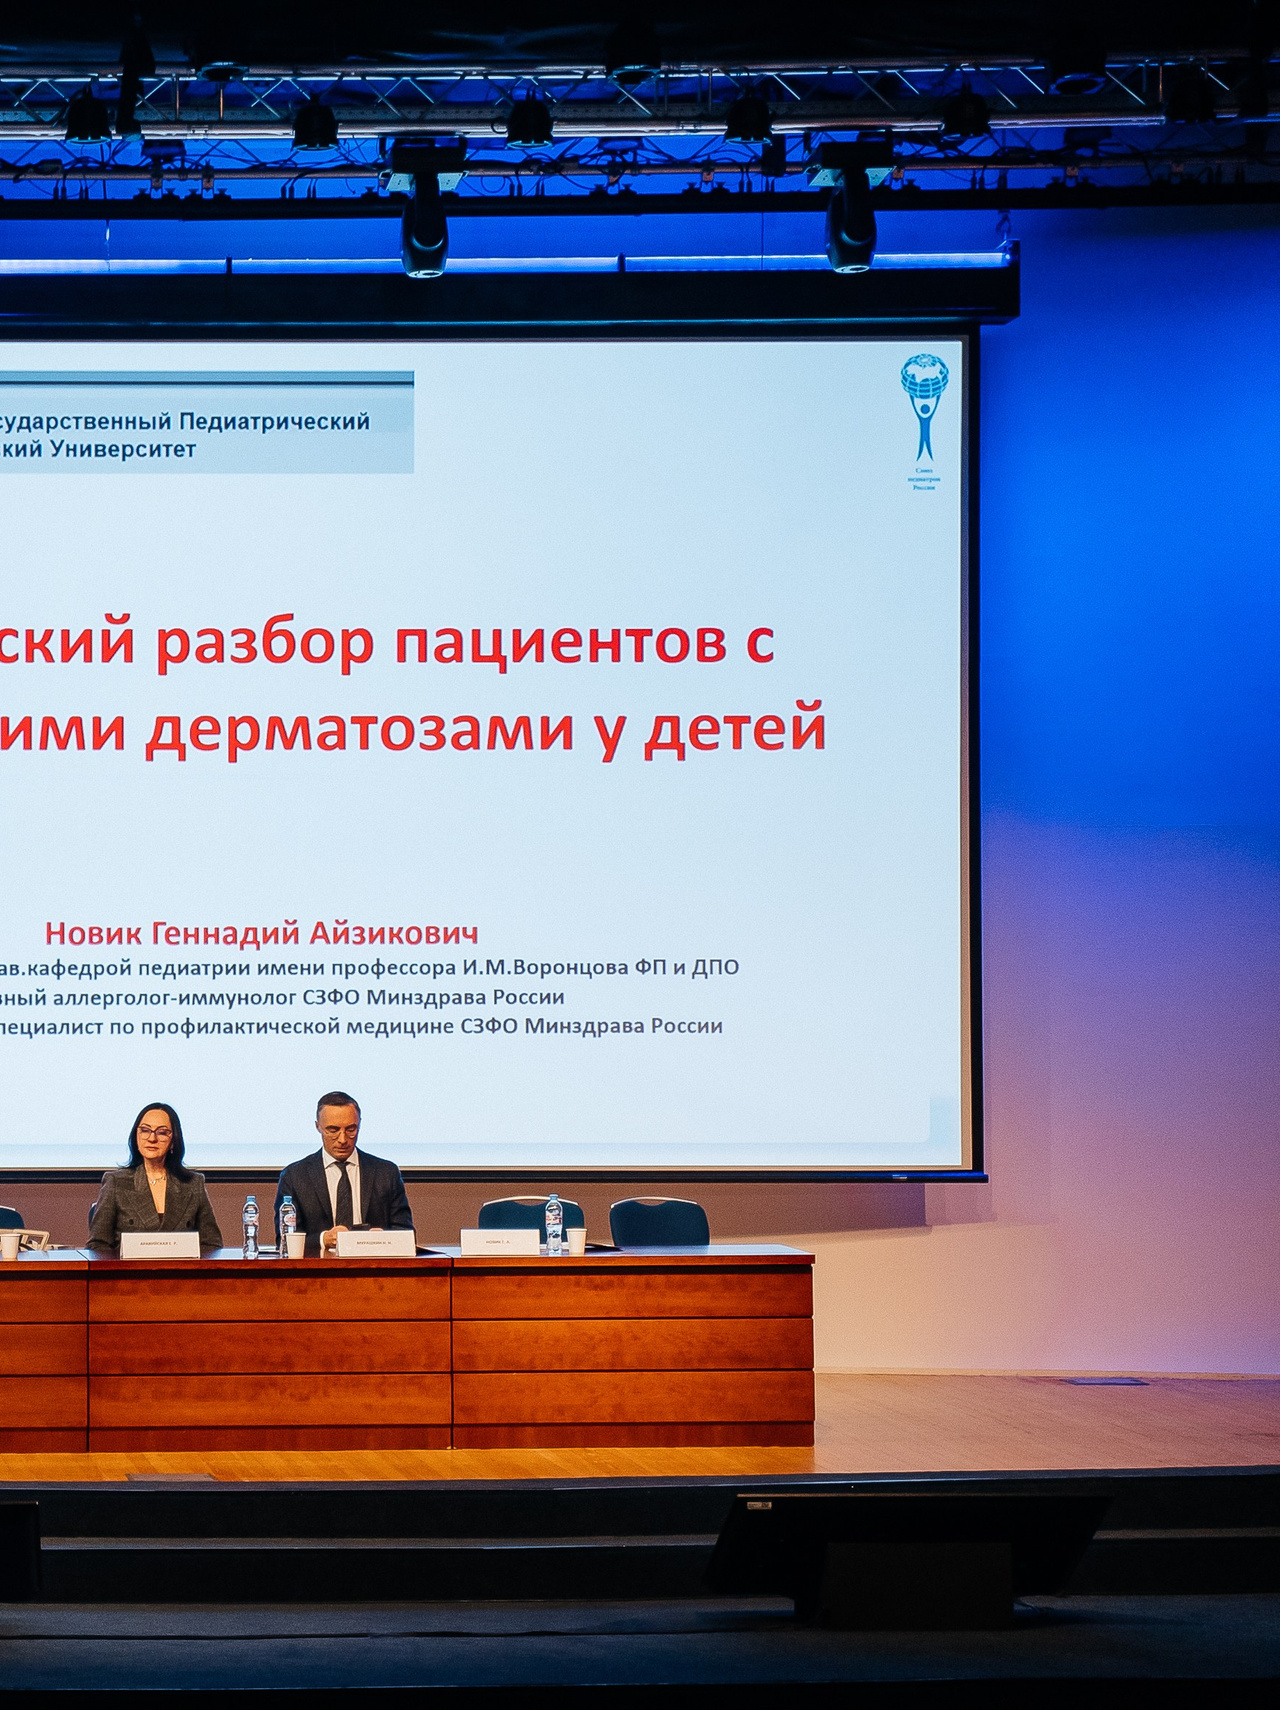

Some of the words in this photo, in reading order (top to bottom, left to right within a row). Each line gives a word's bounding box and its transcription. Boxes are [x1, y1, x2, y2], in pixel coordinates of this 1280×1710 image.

[180, 410, 370, 435] Педиатрический
[49, 438, 197, 462] Университет
[157, 612, 374, 676] разбор
[396, 627, 727, 675] пациентов
[746, 627, 774, 664] с
[145, 714, 573, 764] дерматозами
[593, 715, 628, 764] у
[644, 699, 825, 762] детей
[46, 921, 142, 946] Новик
[152, 918, 300, 951] Геннадий
[309, 918, 478, 946] Айзикович
[138, 963, 251, 981] педиатрии
[257, 963, 325, 976] имени
[331, 957, 456, 980] профессора
[463, 958, 629, 980] И.М.Воронцова
[635, 958, 667, 976] ФП
[673, 962, 686, 976] и
[691, 958, 740, 980] ДПО
[53, 991, 297, 1011] аллерголог-иммунолог
[302, 988, 360, 1006] СЗФО
[367, 989, 487, 1010] Минздрава
[493, 989, 565, 1006] России
[110, 1022, 135, 1036] по
[141, 1016, 340, 1039] профилактической
[346, 1021, 454, 1039] медицине
[460, 1016, 518, 1035] СЗФО
[525, 1017, 645, 1039] Минздрава
[651, 1017, 723, 1035] России
